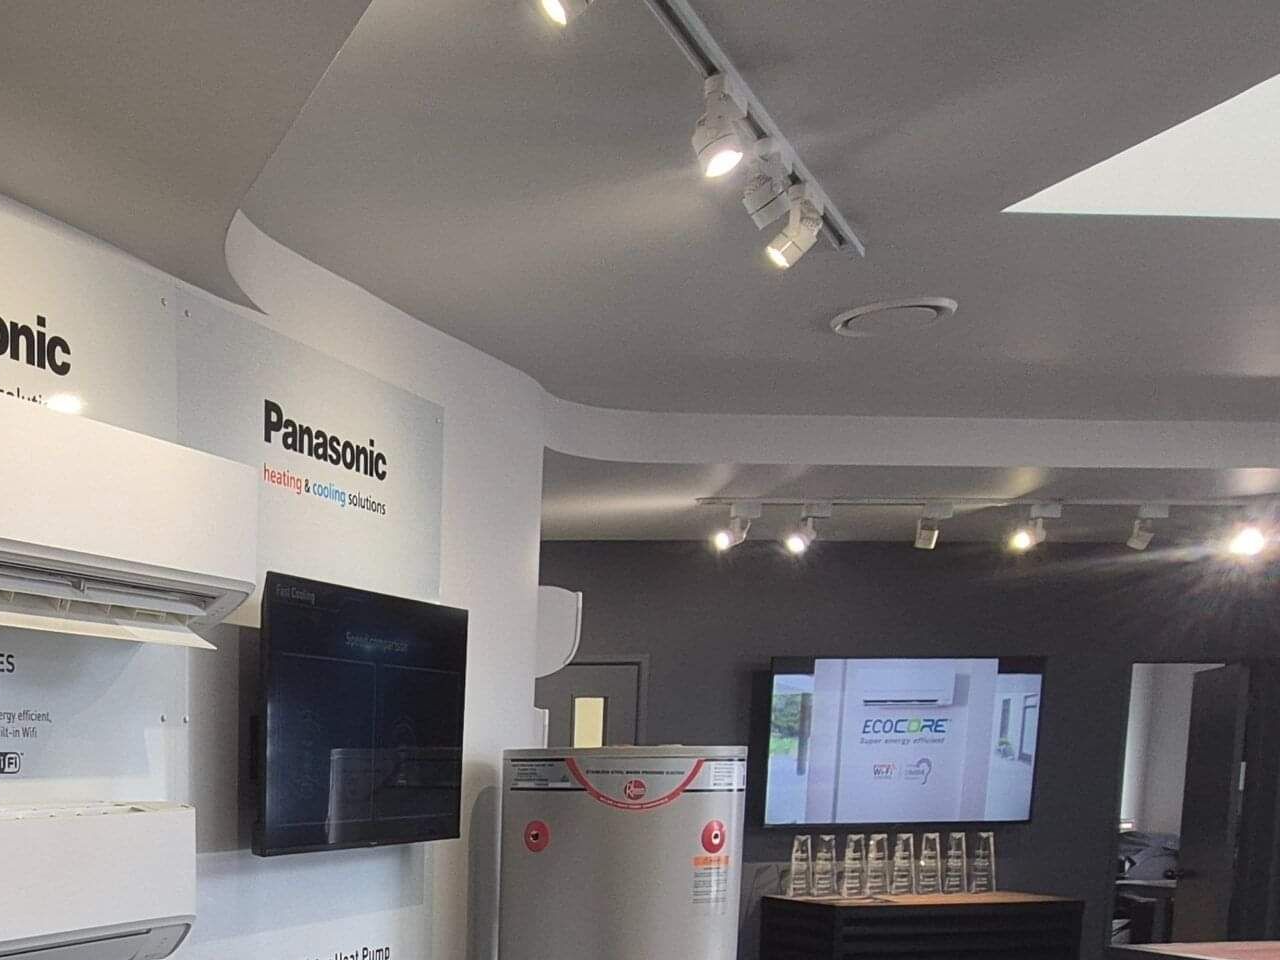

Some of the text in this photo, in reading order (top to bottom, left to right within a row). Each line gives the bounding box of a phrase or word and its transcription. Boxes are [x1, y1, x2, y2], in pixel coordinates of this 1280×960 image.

[264, 399, 387, 481] Panasonic
[263, 463, 386, 516] heating & cooling solutions
[17, 709, 52, 723] efficient,
